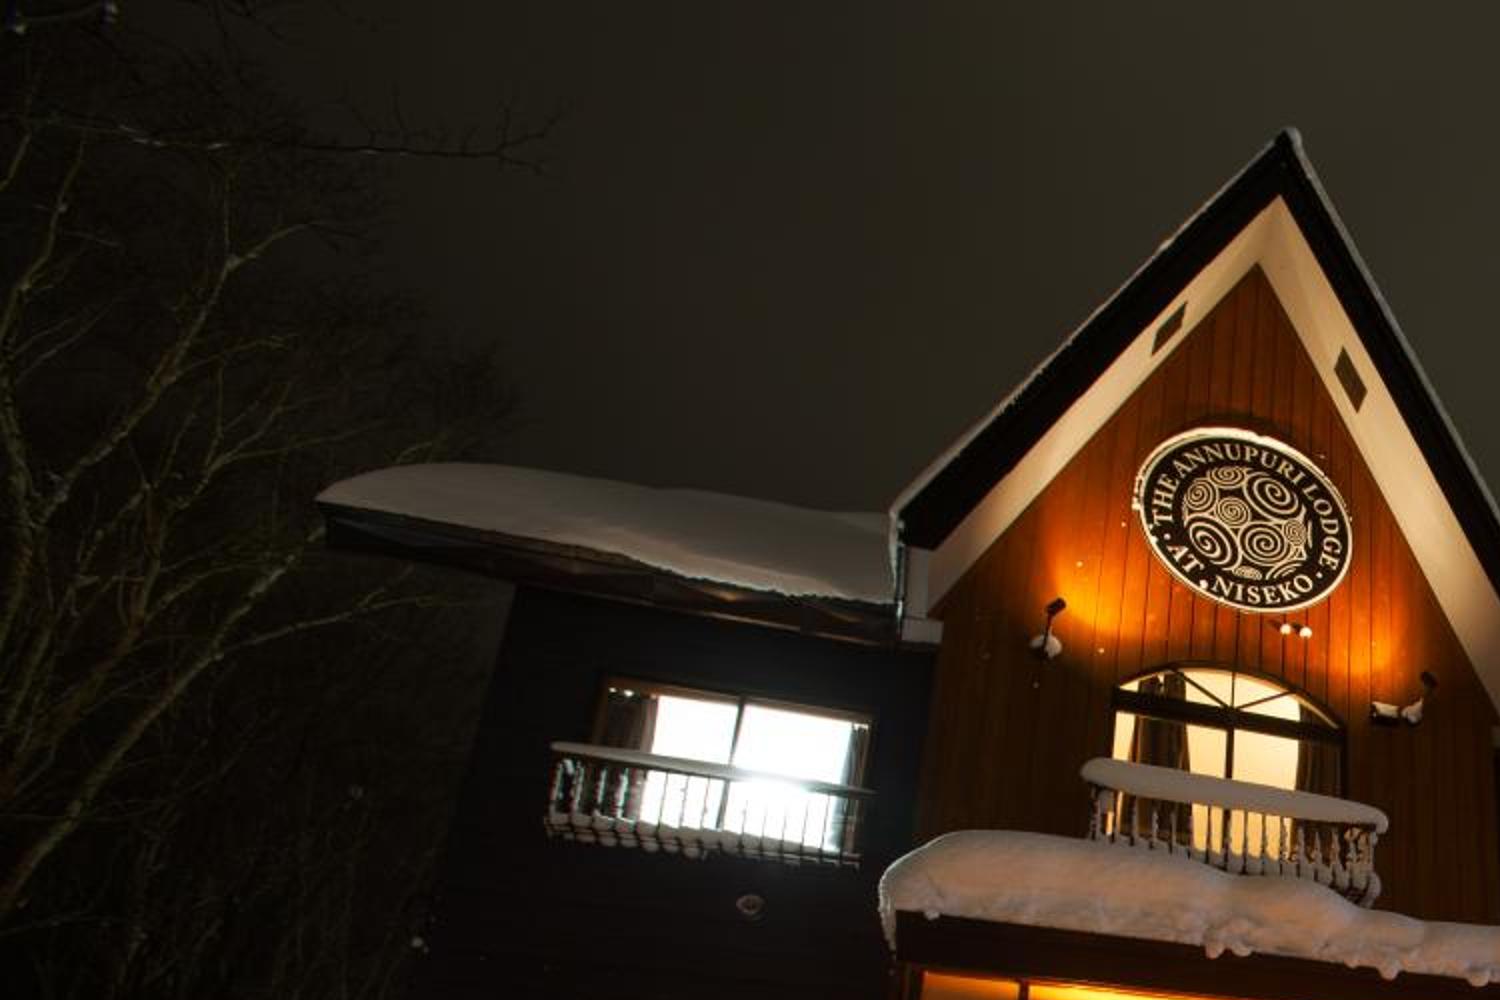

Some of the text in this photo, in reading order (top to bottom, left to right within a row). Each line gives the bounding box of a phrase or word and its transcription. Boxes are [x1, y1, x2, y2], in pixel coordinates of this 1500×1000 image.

[1152, 443, 1342, 570] THE ANNUPURI LODGE
[1167, 543, 1313, 604] AT NISEKO
